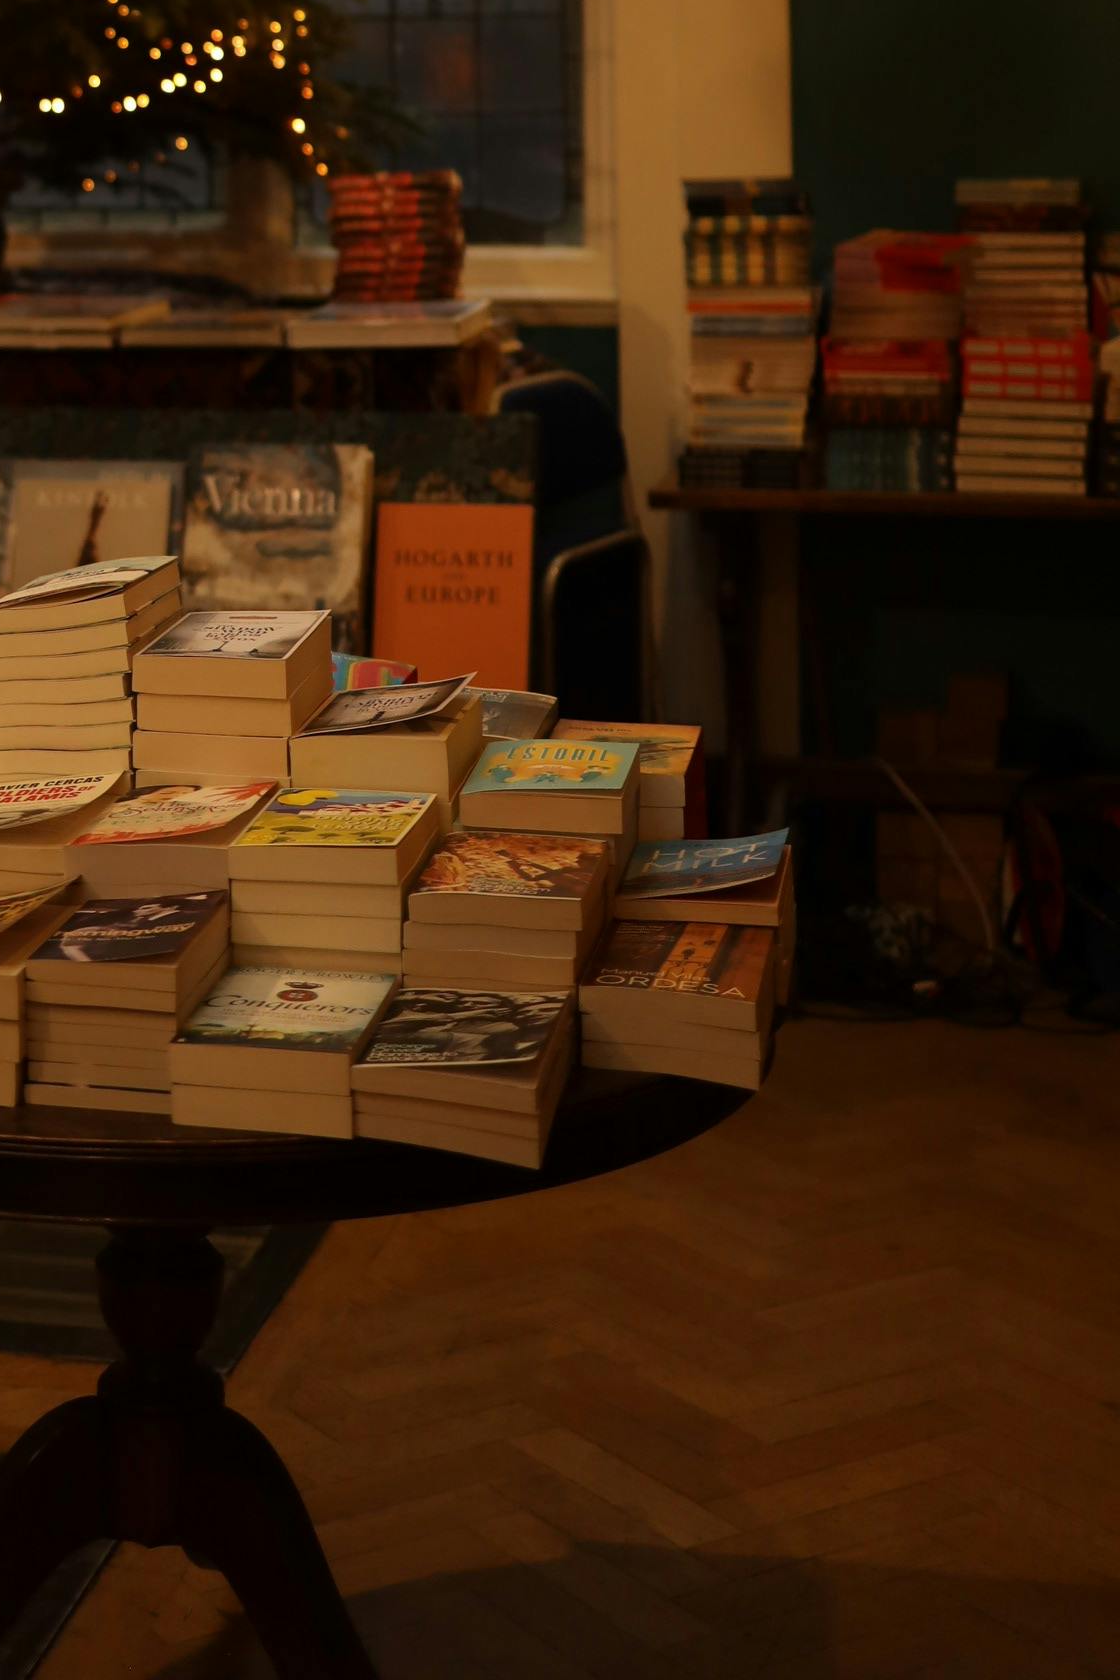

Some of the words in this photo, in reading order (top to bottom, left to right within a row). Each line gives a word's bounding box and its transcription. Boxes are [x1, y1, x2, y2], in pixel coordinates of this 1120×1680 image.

[202, 473, 337, 517] Vienna
[394, 548, 514, 568] HOGARTH
[406, 583, 499, 605] EUROPE
[506, 746, 610, 762] ESTORIL
[44, 775, 104, 788] CERCAS
[651, 840, 768, 860] HOT
[640, 850, 768, 874] MILK
[600, 968, 666, 978] Manuel
[670, 971, 712, 982] Vilas
[595, 974, 746, 999] ORDESA
[204, 994, 375, 1016] Conquerors
